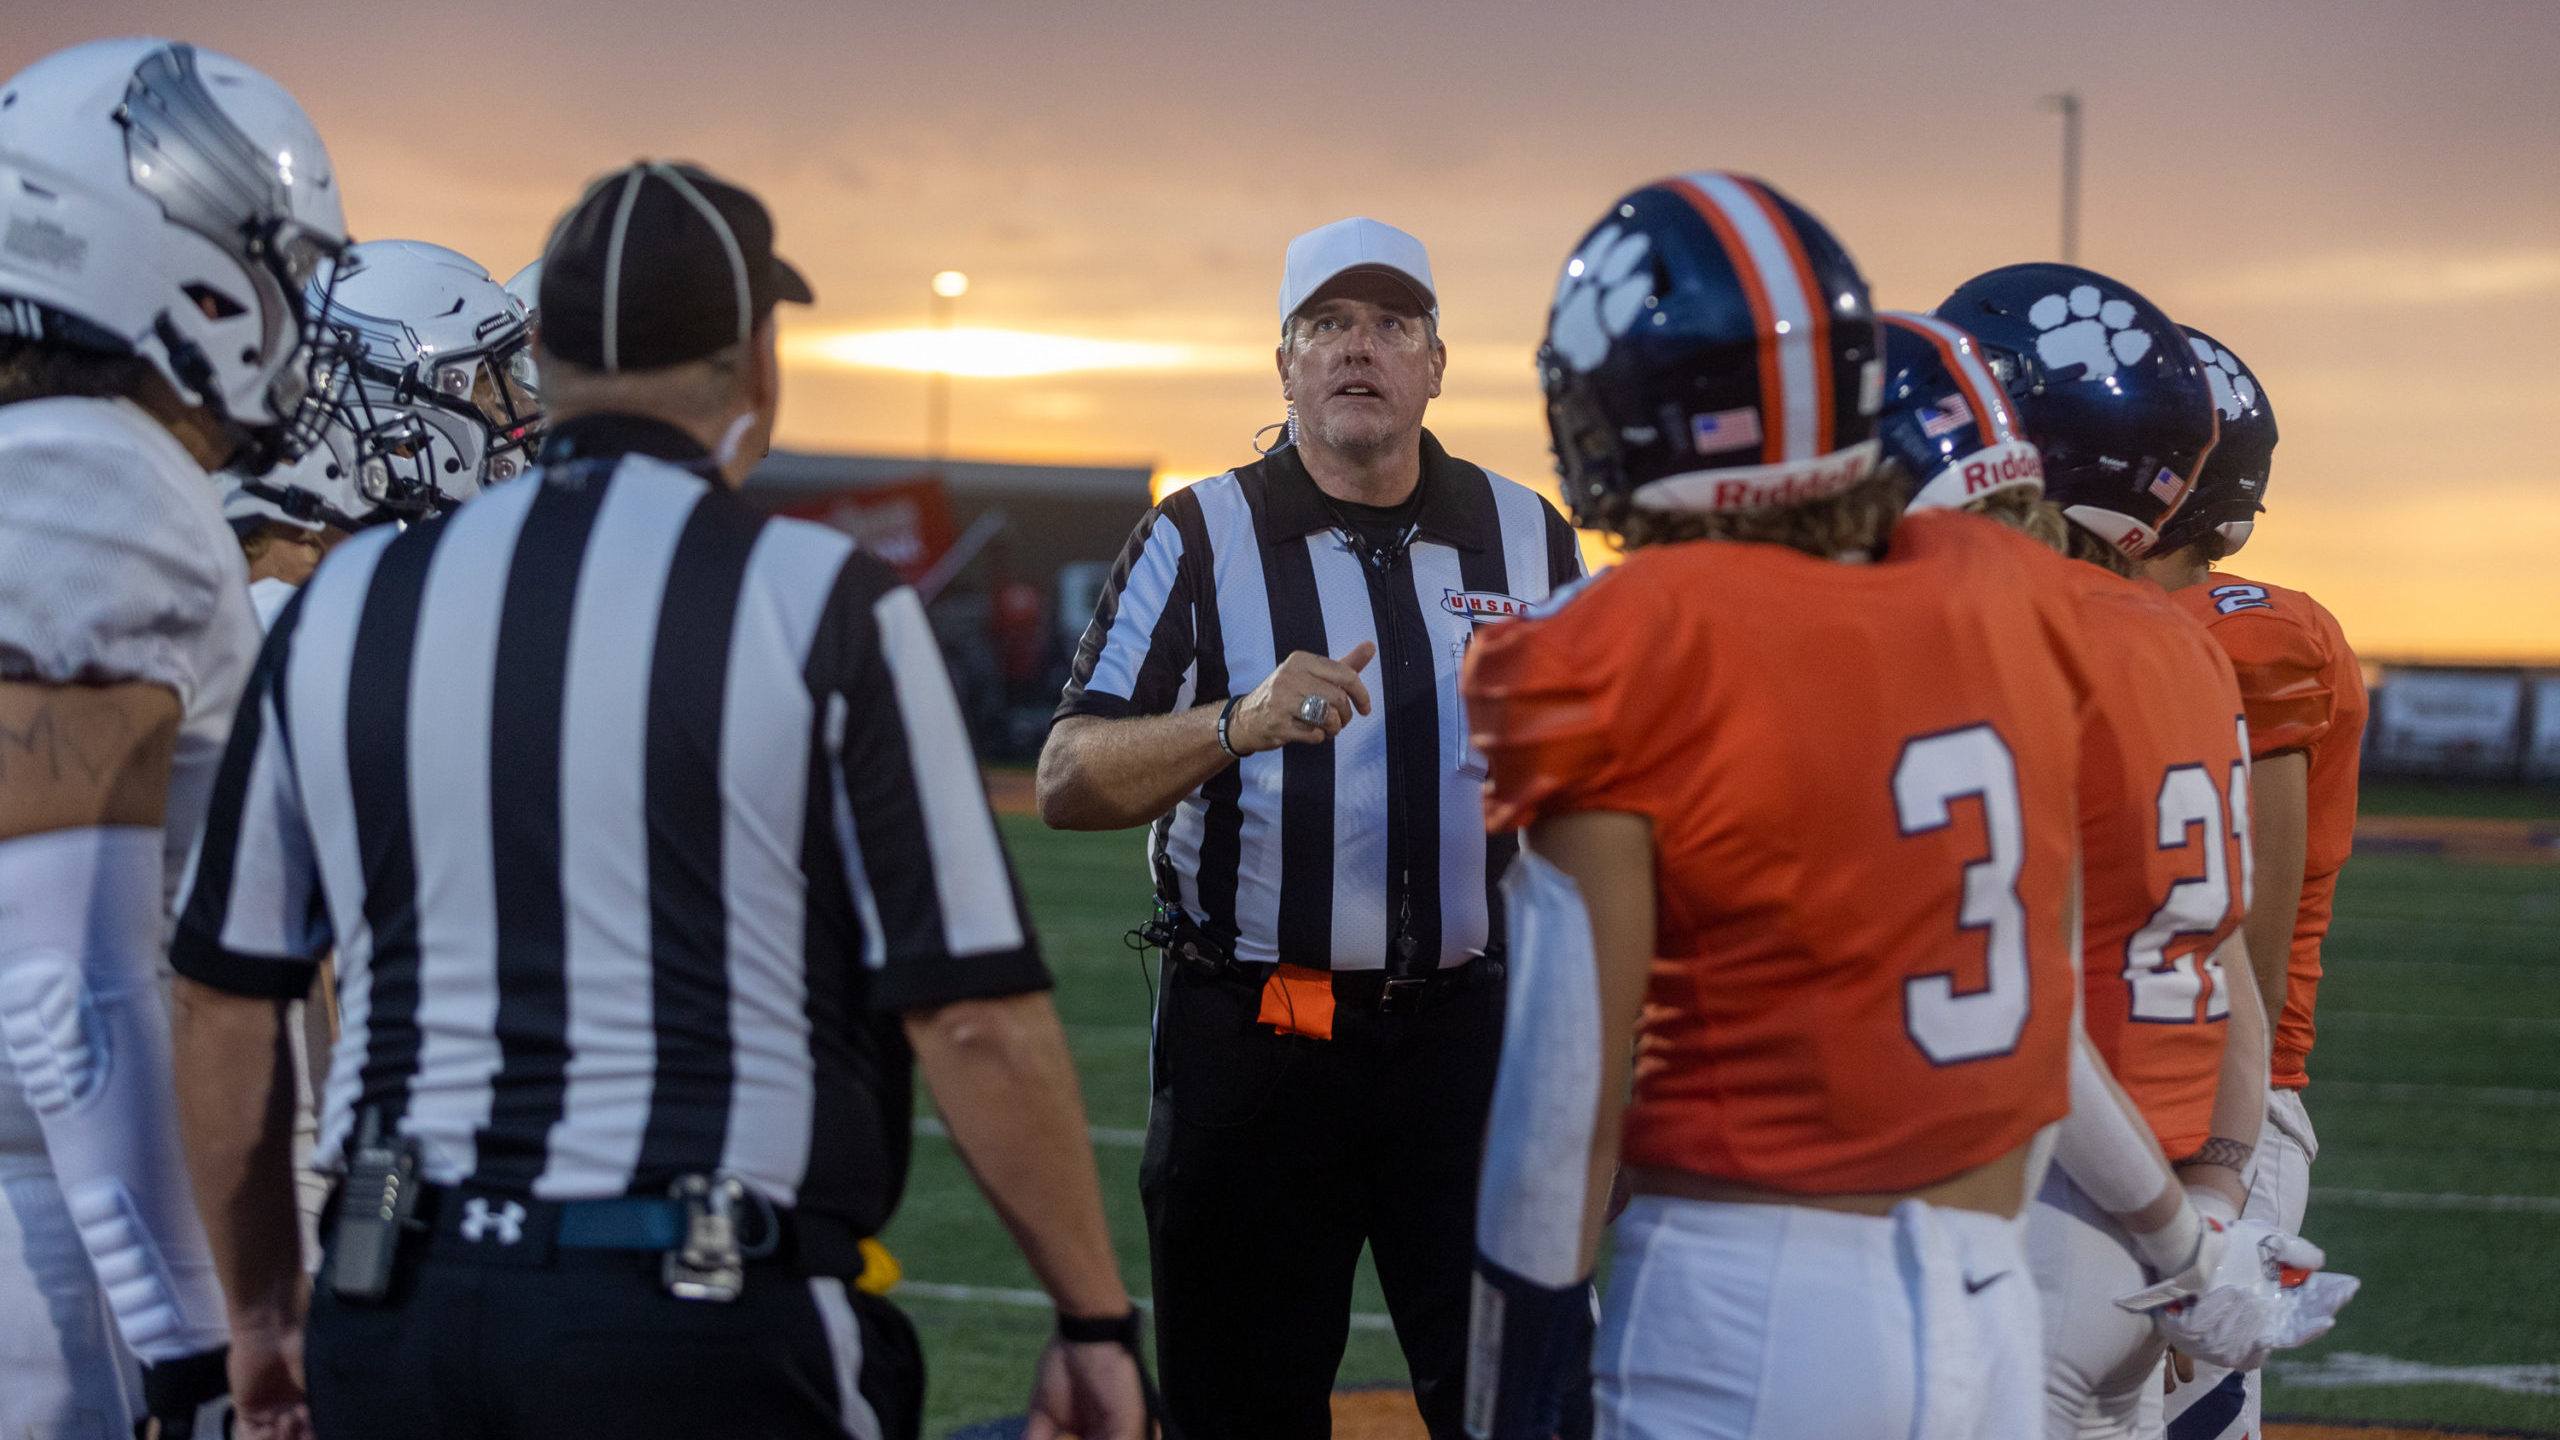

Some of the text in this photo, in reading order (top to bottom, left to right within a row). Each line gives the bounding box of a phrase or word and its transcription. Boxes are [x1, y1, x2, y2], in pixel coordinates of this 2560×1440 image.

[1964, 449, 2042, 495] Ridde
[2209, 584, 2275, 615] 2
[1890, 720, 2032, 1067] 3
